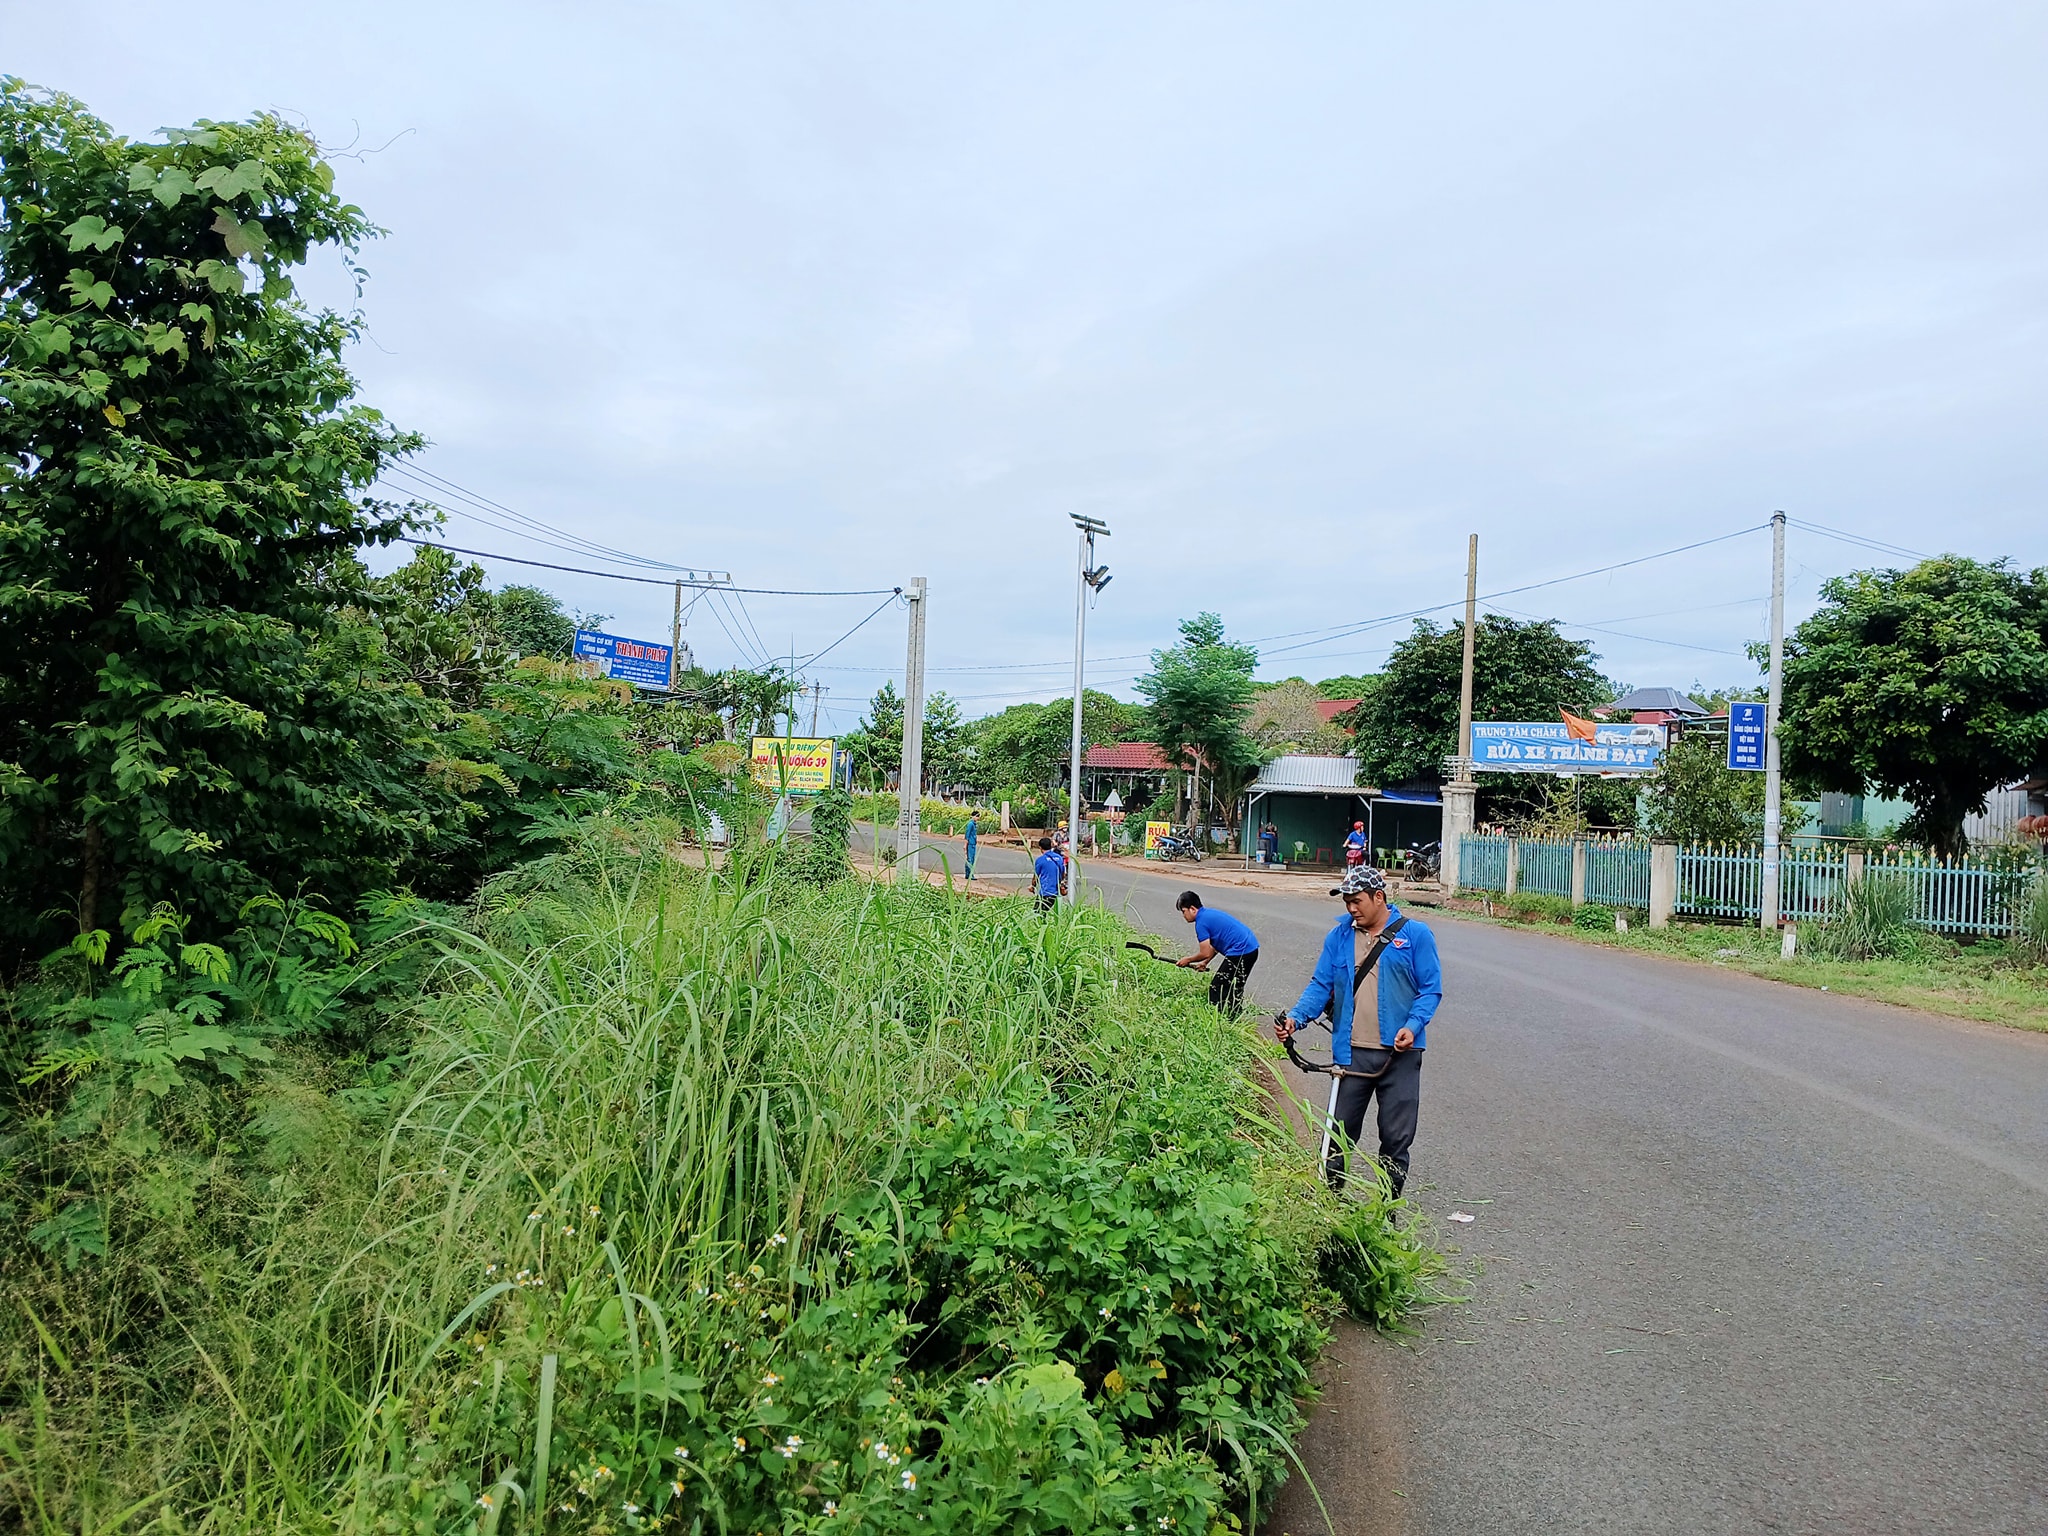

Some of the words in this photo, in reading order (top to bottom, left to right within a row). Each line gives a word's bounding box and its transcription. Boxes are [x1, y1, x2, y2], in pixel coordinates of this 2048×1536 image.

[616, 641, 644, 660] THÀNH
[645, 646, 668, 663] PHÁT
[1475, 726, 1506, 737] TRUNG
[1508, 725, 1528, 737] TÂM
[1530, 725, 1557, 737] CHĂM
[1487, 740, 1521, 758] RỬA
[1524, 746, 1546, 759] XE
[1550, 743, 1608, 761] THÀNH
[1611, 748, 1648, 766] ĐẠT
[815, 757, 827, 768] 39
[1148, 824, 1167, 836] RỬA
